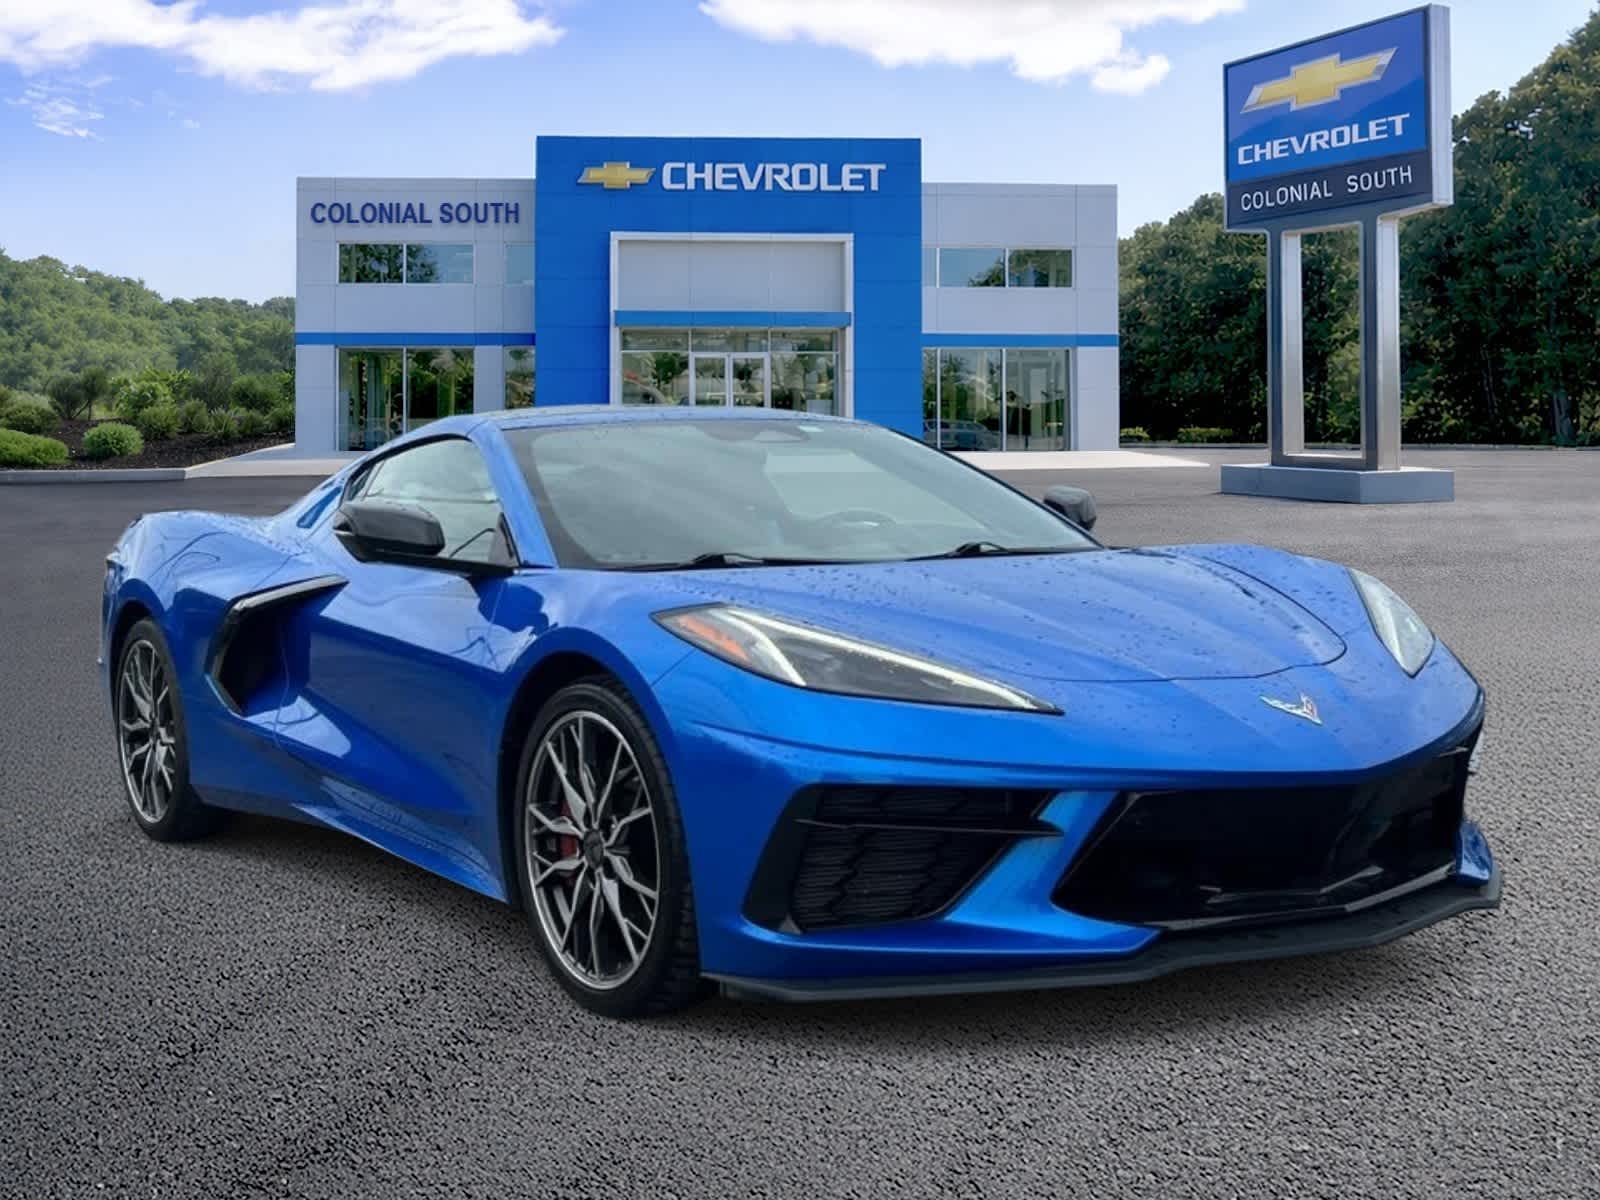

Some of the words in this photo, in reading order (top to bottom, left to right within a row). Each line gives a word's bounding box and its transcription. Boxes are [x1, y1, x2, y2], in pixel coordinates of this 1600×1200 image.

[1237, 113, 1410, 165] CHEVROLET
[661, 161, 887, 192] CHEVROLET
[1241, 180, 1333, 211] COLONIAL
[1346, 165, 1413, 193] SOUTH
[310, 202, 433, 224] COLONIAL
[439, 202, 520, 224] SOUTH
